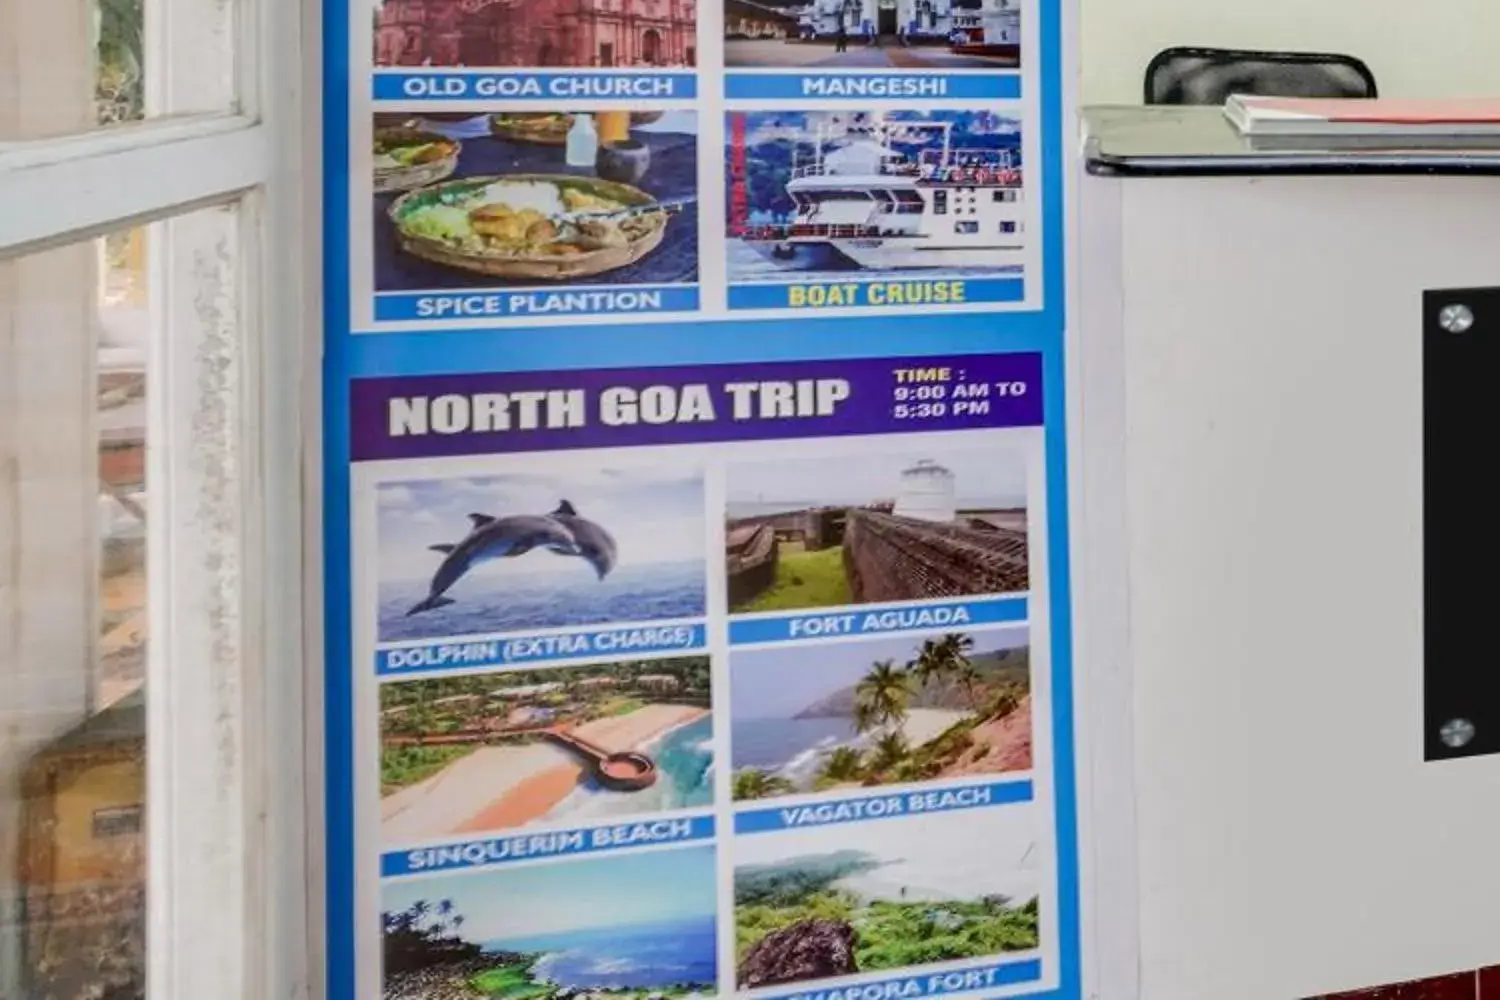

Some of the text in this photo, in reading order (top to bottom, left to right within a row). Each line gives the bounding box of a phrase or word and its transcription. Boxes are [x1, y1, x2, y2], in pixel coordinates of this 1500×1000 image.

[403, 76, 674, 97] OLD GOA CHURCH
[801, 76, 948, 96] MANGESHI
[416, 290, 661, 317] SPICE PLANTION
[788, 281, 965, 307] BOAT CRUISE
[893, 380, 1027, 401] 9:00 AM TO
[389, 378, 851, 437] NORTH GOA TRIP
[893, 400, 990, 419] 5:30 PM
[788, 606, 970, 638] FORT AGUADA
[386, 625, 698, 669] DOLPHIN (EXTRA CHARGE)
[780, 786, 992, 826] VAGATOR BEACH
[406, 820, 693, 870] SINQUERIM BEACH
[788, 967, 999, 1000] APORA FORT
